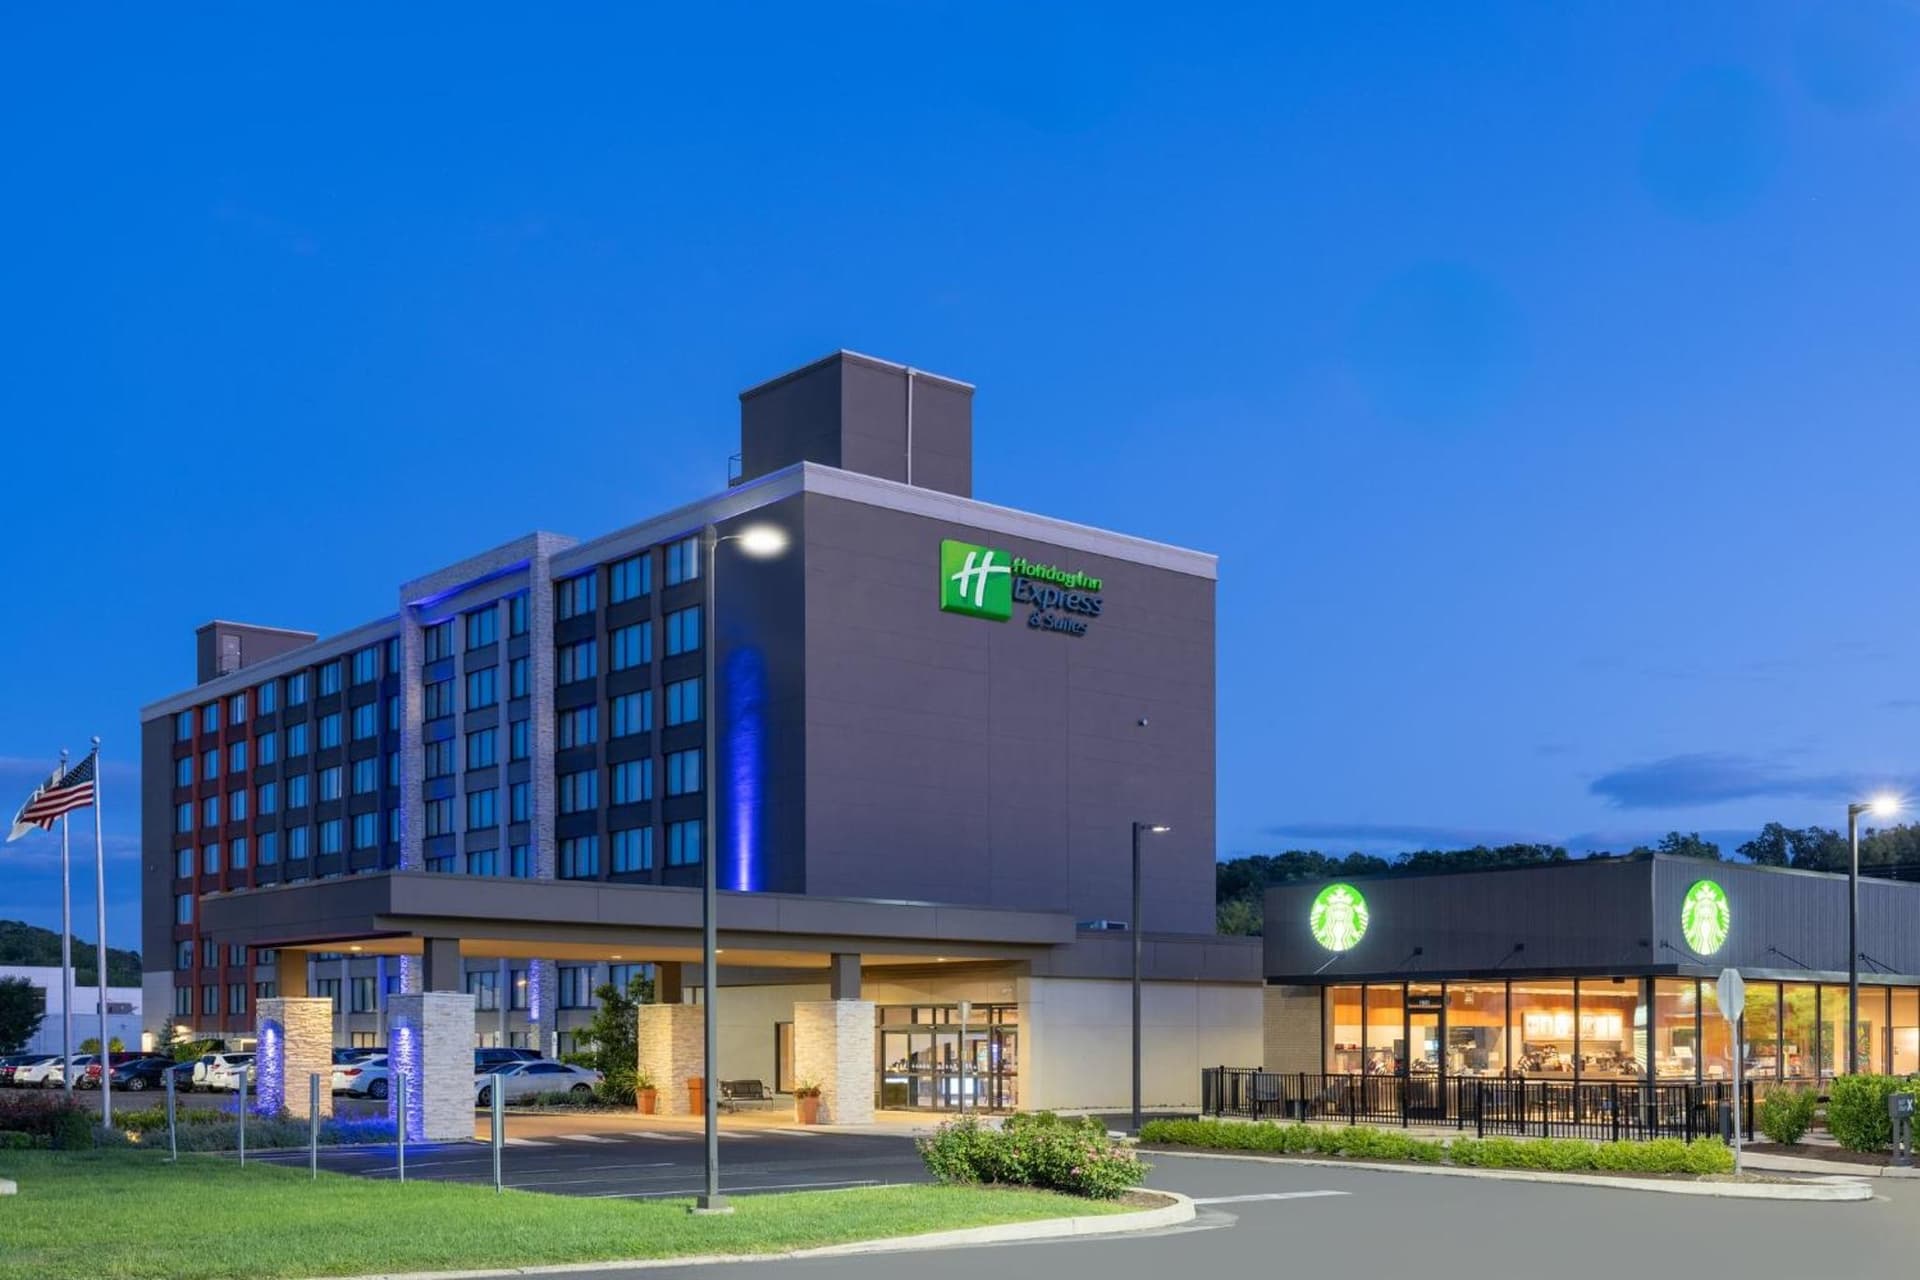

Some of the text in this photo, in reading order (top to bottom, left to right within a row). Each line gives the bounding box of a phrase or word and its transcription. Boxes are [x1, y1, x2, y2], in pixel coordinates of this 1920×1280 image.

[1014, 576, 1104, 615] Express
[1030, 609, 1088, 635] & Suites
